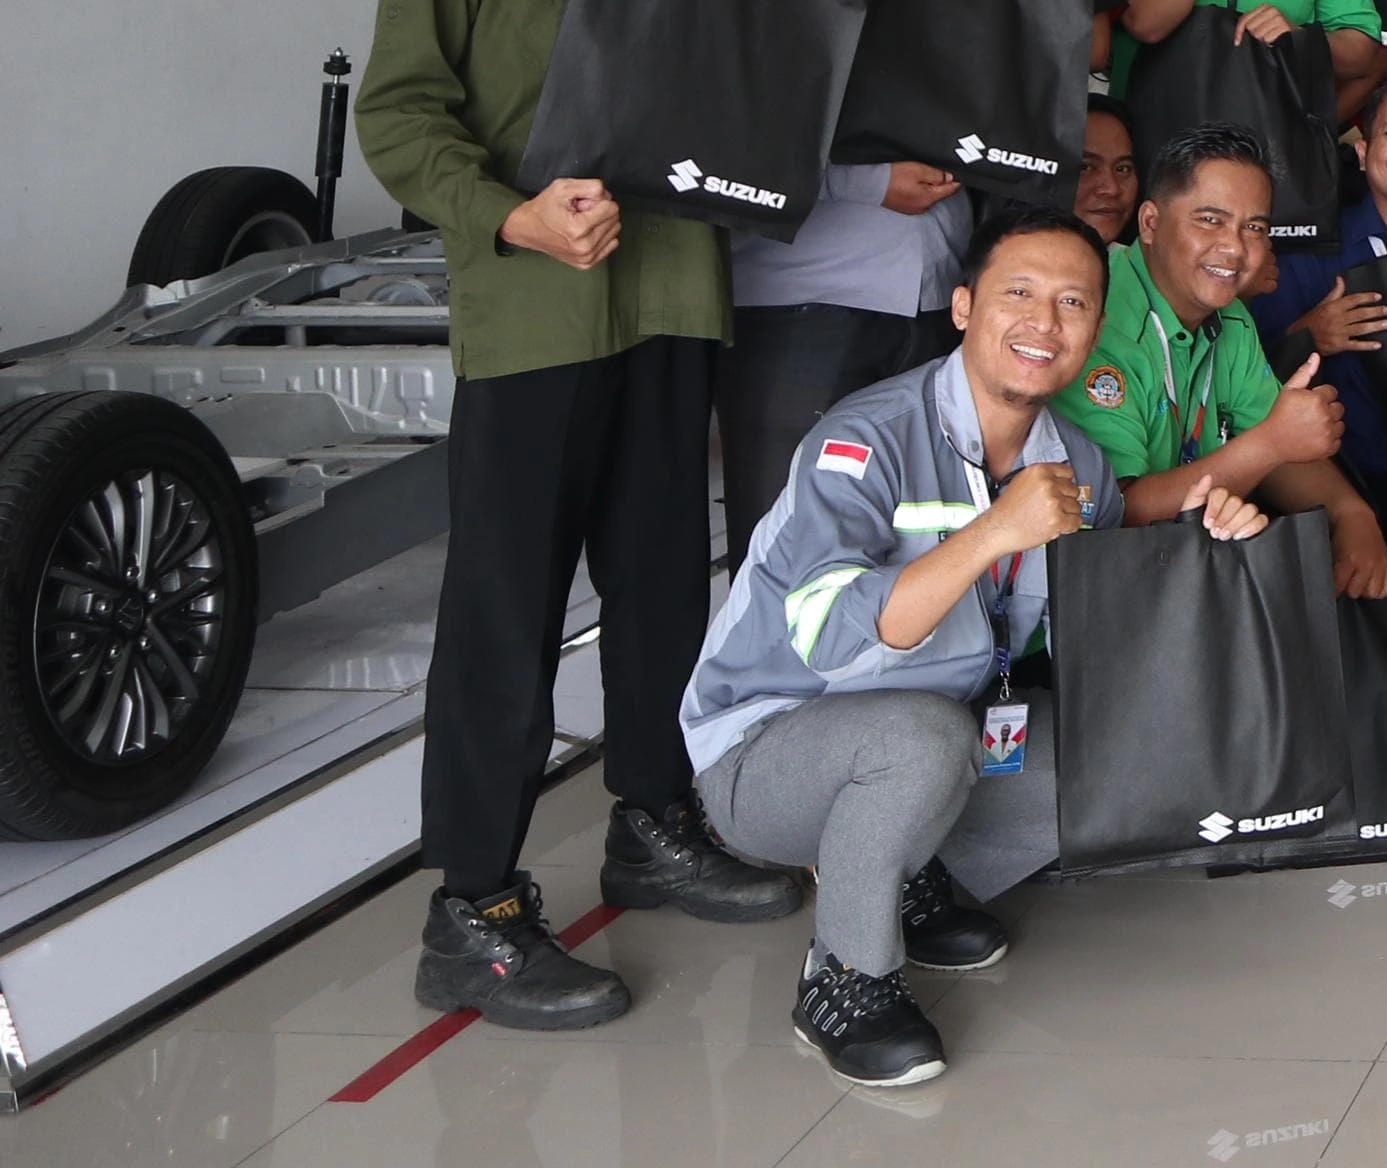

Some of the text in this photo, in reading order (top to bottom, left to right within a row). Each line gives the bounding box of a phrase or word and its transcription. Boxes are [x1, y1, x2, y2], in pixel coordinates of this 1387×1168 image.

[987, 146, 1059, 176] SUZUKI
[703, 174, 787, 211] SUZUKI
[1237, 805, 1324, 833] SUZUKI
